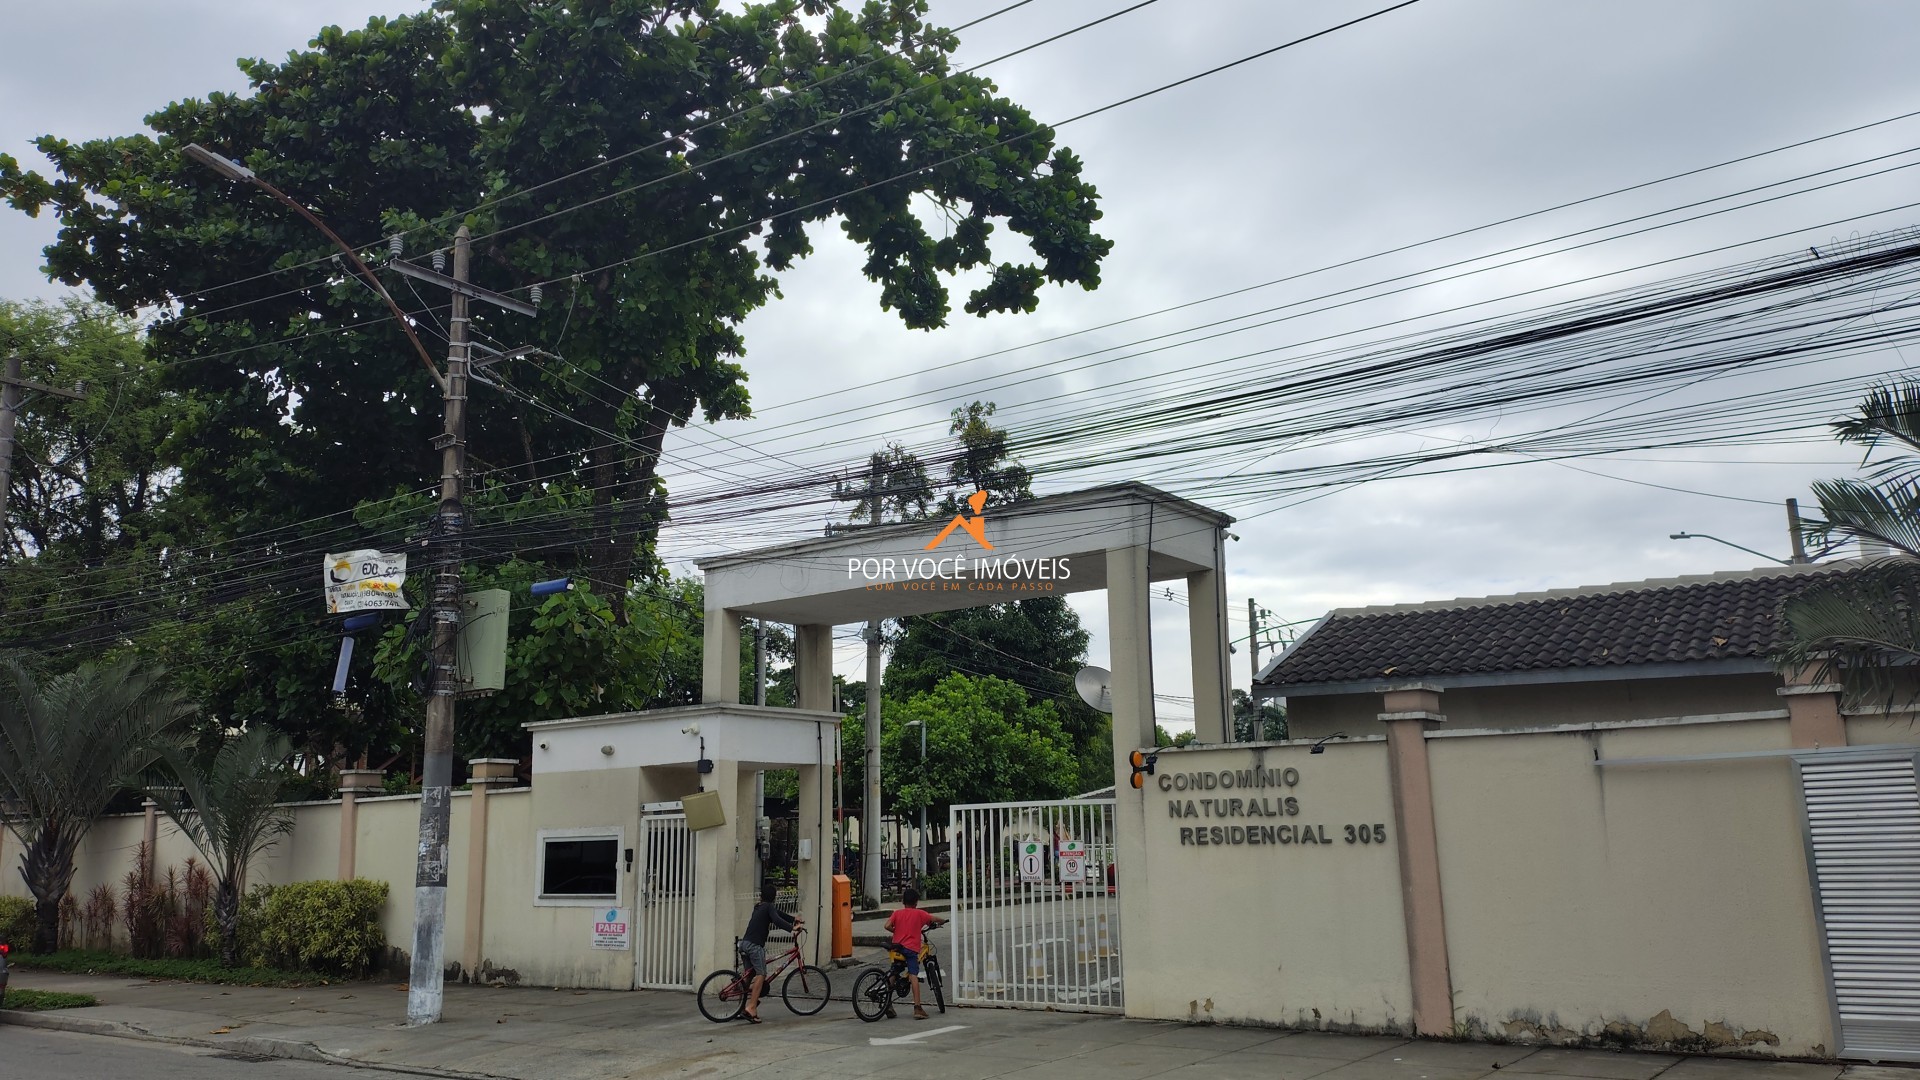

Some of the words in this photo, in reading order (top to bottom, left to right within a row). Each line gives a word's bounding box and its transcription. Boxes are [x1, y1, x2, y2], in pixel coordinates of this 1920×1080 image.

[1158, 765, 1299, 792] CONDOMÍNIO
[1168, 797, 1299, 818] NATURALIS
[1180, 824, 1332, 845] RESIDENCIAL
[1343, 823, 1387, 844] 305
[598, 923, 624, 933] PARE
